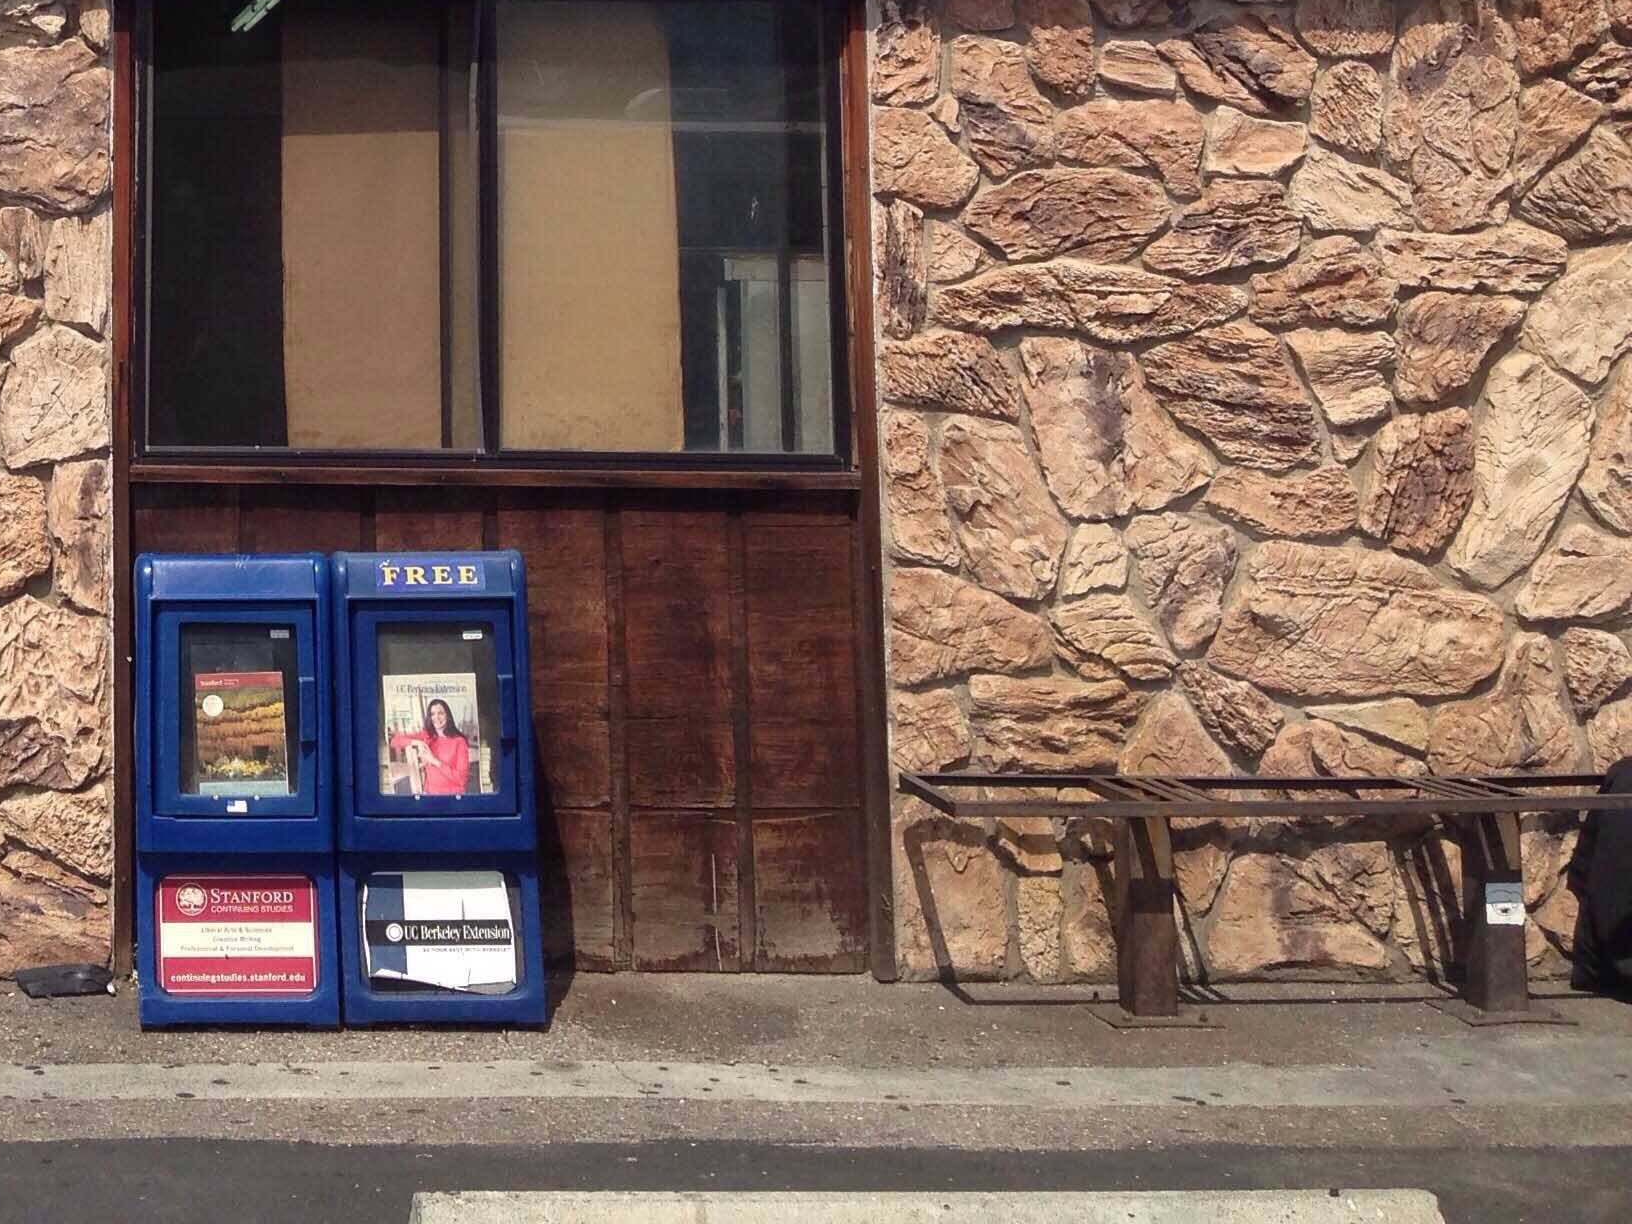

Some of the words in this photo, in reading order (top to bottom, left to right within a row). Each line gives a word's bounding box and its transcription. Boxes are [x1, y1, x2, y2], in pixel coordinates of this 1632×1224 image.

[381, 565, 478, 585] FREE
[210, 888, 293, 904] STANFORD
[211, 905, 259, 913] CONTINUING
[261, 905, 293, 913] STUDIES
[404, 926, 418, 940] UC
[421, 925, 462, 943] Berkeley
[463, 925, 510, 940] Extension
[171, 973, 305, 984] continuingstudies.stanford.edu
